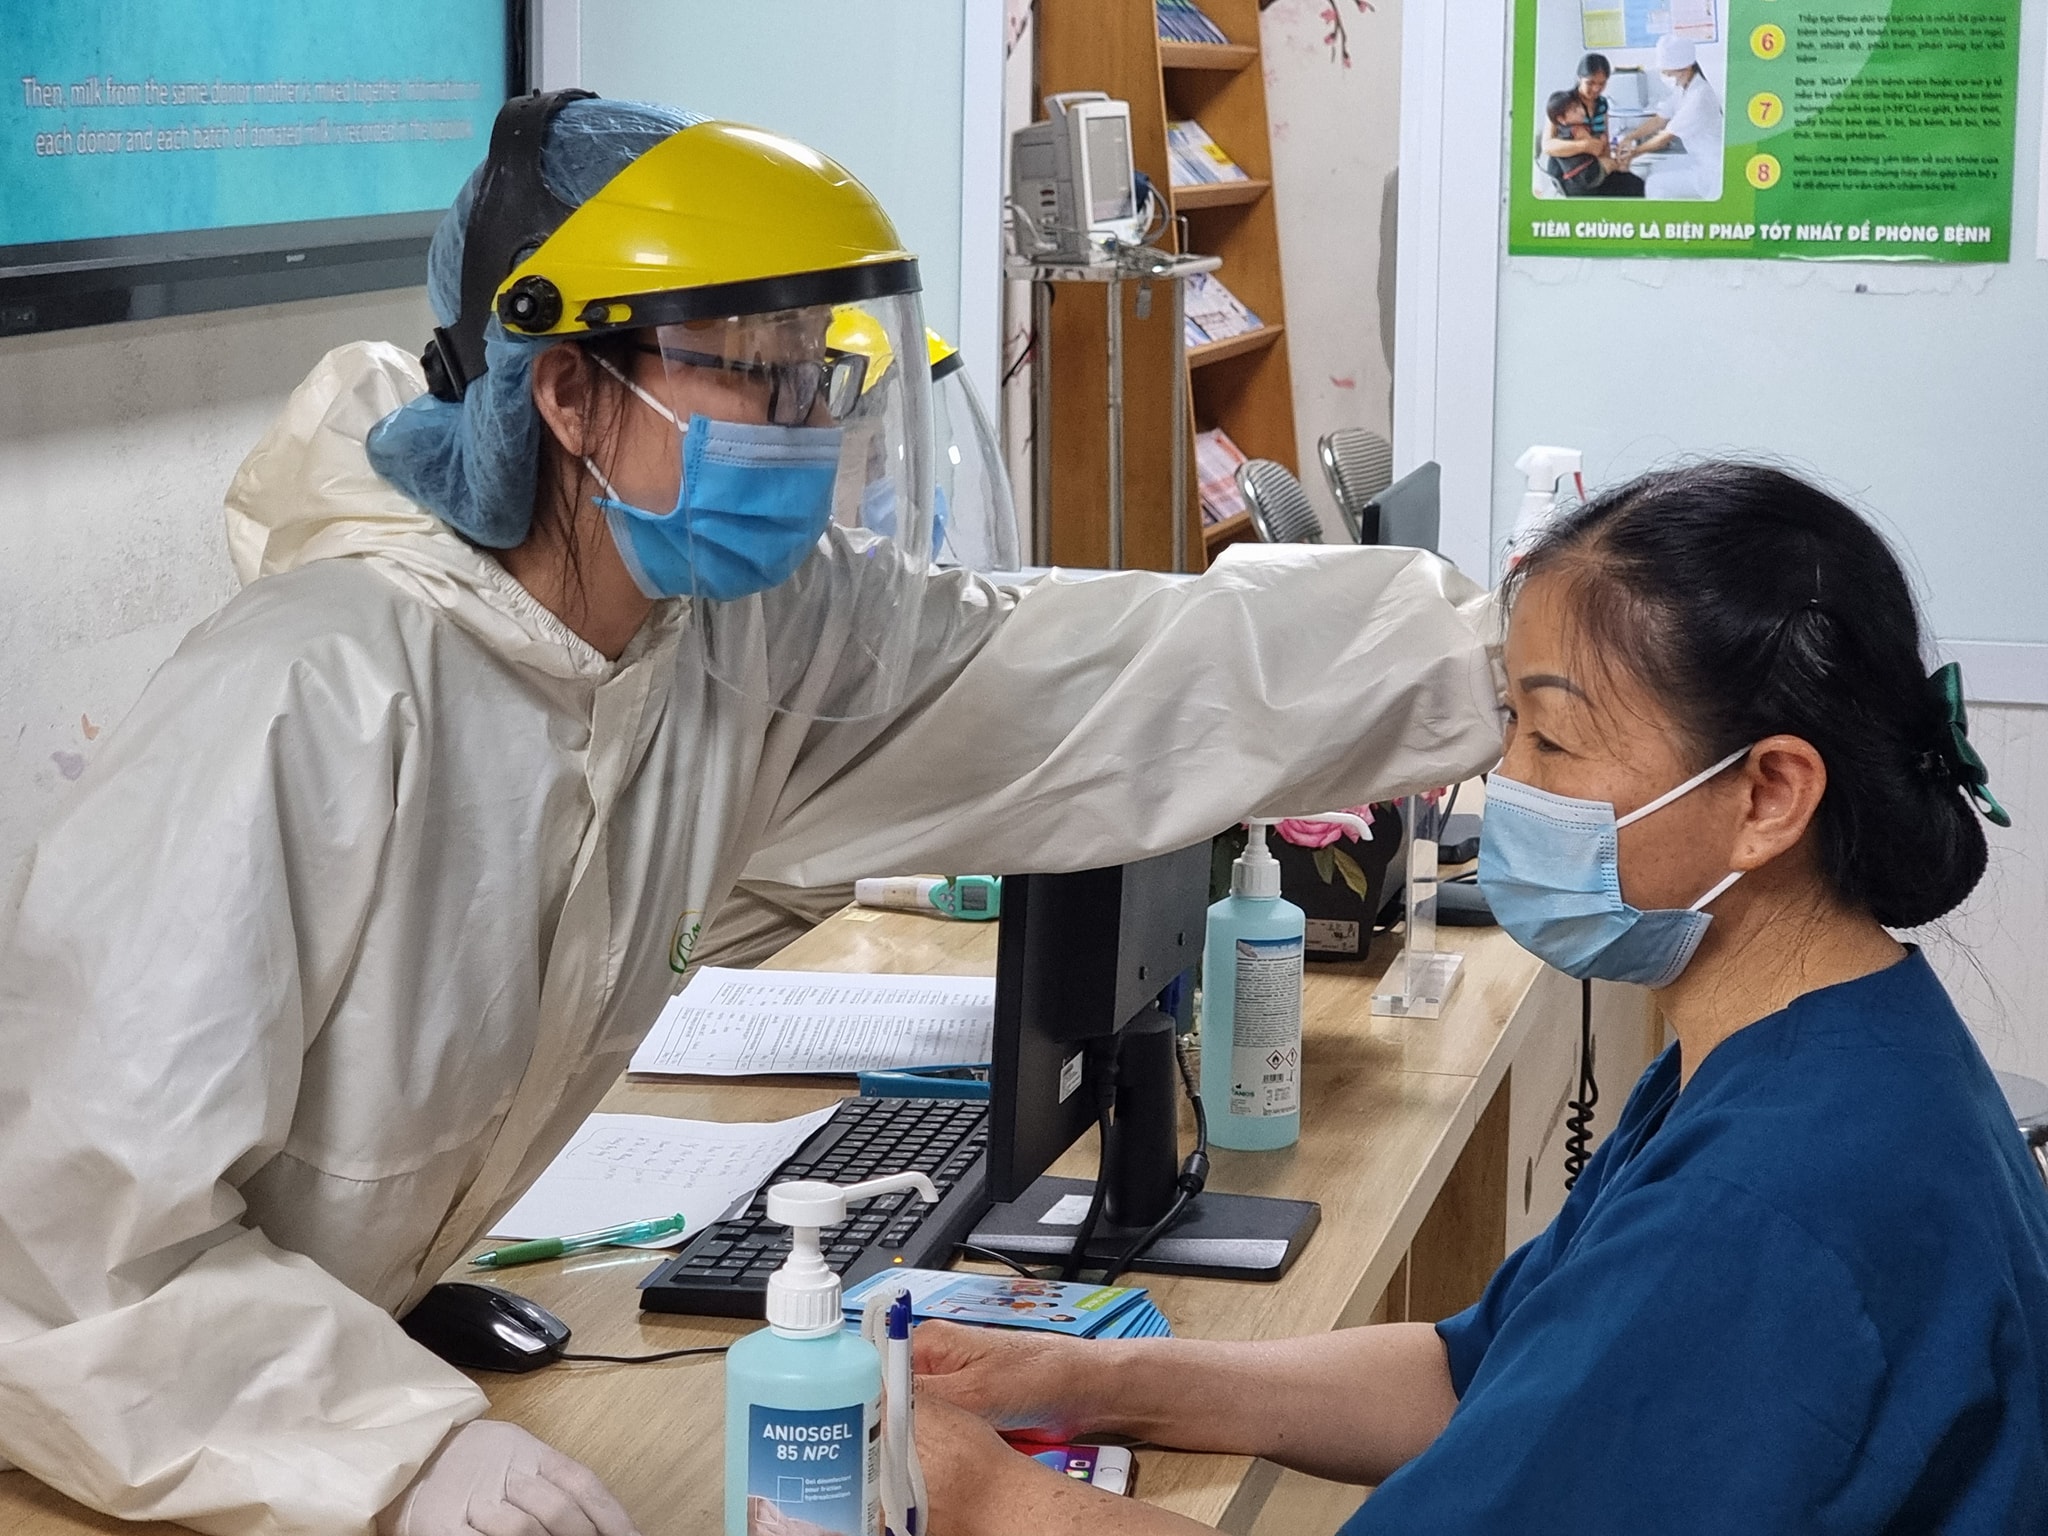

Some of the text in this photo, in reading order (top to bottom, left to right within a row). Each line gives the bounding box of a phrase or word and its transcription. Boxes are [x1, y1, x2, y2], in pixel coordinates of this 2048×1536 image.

[1761, 33, 1774, 51] 6
[22, 77, 66, 110] Then,
[71, 77, 101, 106] milk
[106, 77, 140, 106] from
[145, 79, 168, 105] the
[172, 83, 208, 104] same
[211, 79, 250, 104] donor
[1760, 102, 1773, 120] 7
[36, 124, 72, 156] each
[77, 124, 122, 154] donor
[126, 122, 152, 152] and
[157, 121, 188, 150] each
[234, 119, 248, 148] of
[1757, 164, 1770, 183] 8
[1665, 221, 1704, 243] BIỆN
[1943, 222, 1991, 246] BỆNH
[763, 1423, 852, 1442] ANIOSGEL
[776, 1444, 840, 1461] 85 NPC
